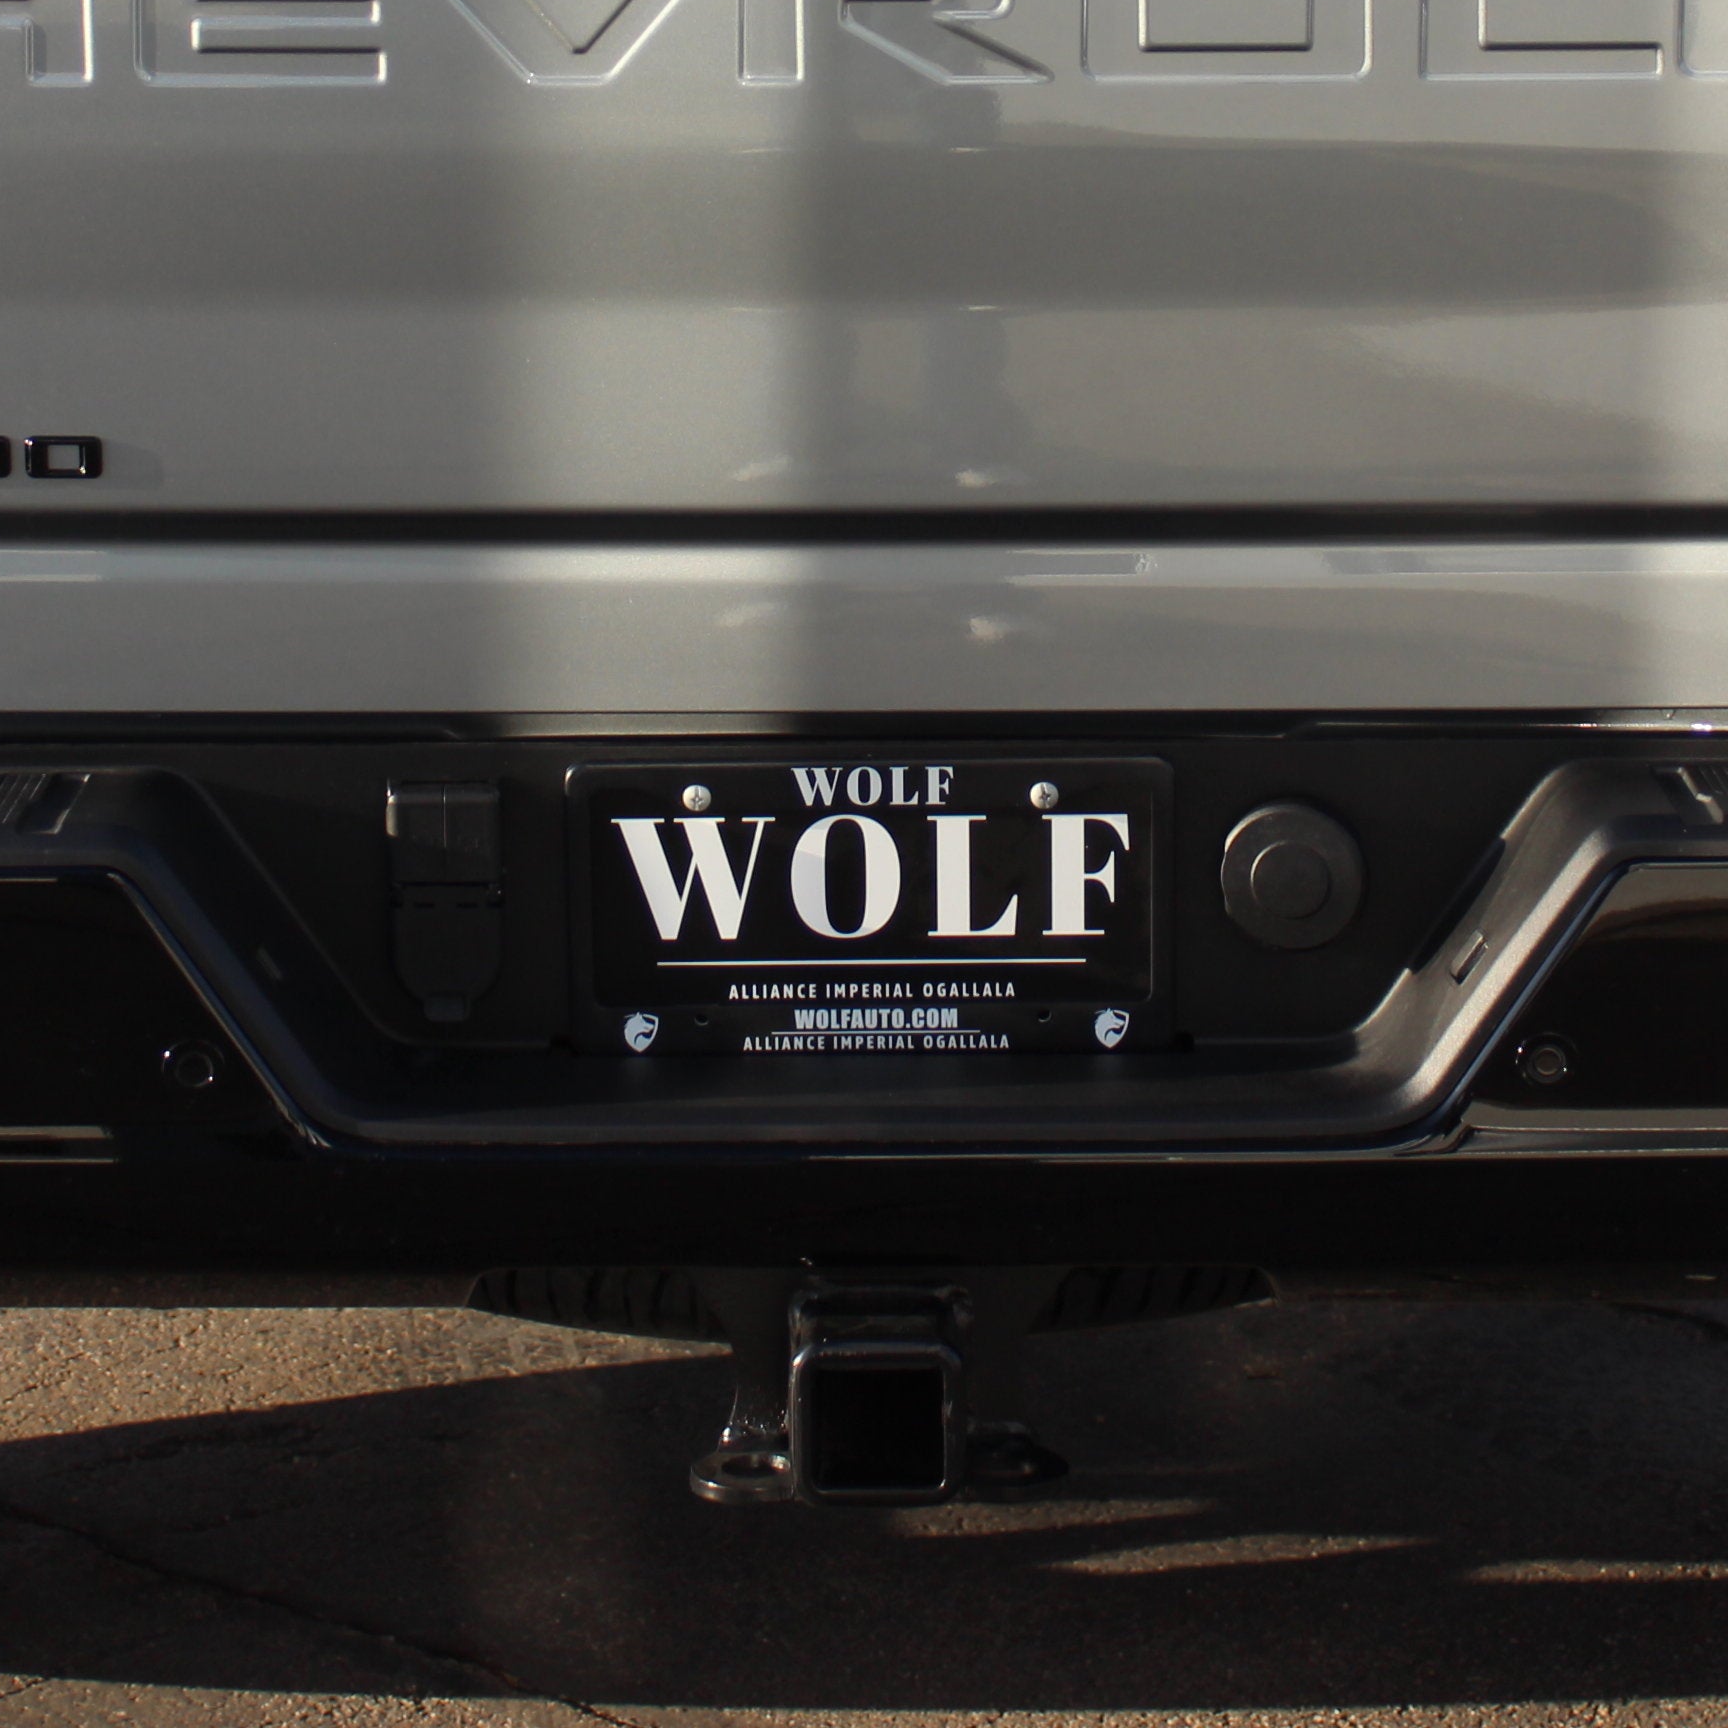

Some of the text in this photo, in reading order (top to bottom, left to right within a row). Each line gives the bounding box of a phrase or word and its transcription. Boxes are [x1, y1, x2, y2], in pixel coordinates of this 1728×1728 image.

[791, 765, 955, 807] WOLF
[610, 813, 1131, 940] WOLF
[728, 981, 1016, 1000] ALLIANCE IMPERIAL OGALLALA
[794, 1007, 959, 1030] WOLFAUTO.COM
[743, 1033, 1010, 1052] ALLIANCE IMPERIAL OGALLALA
